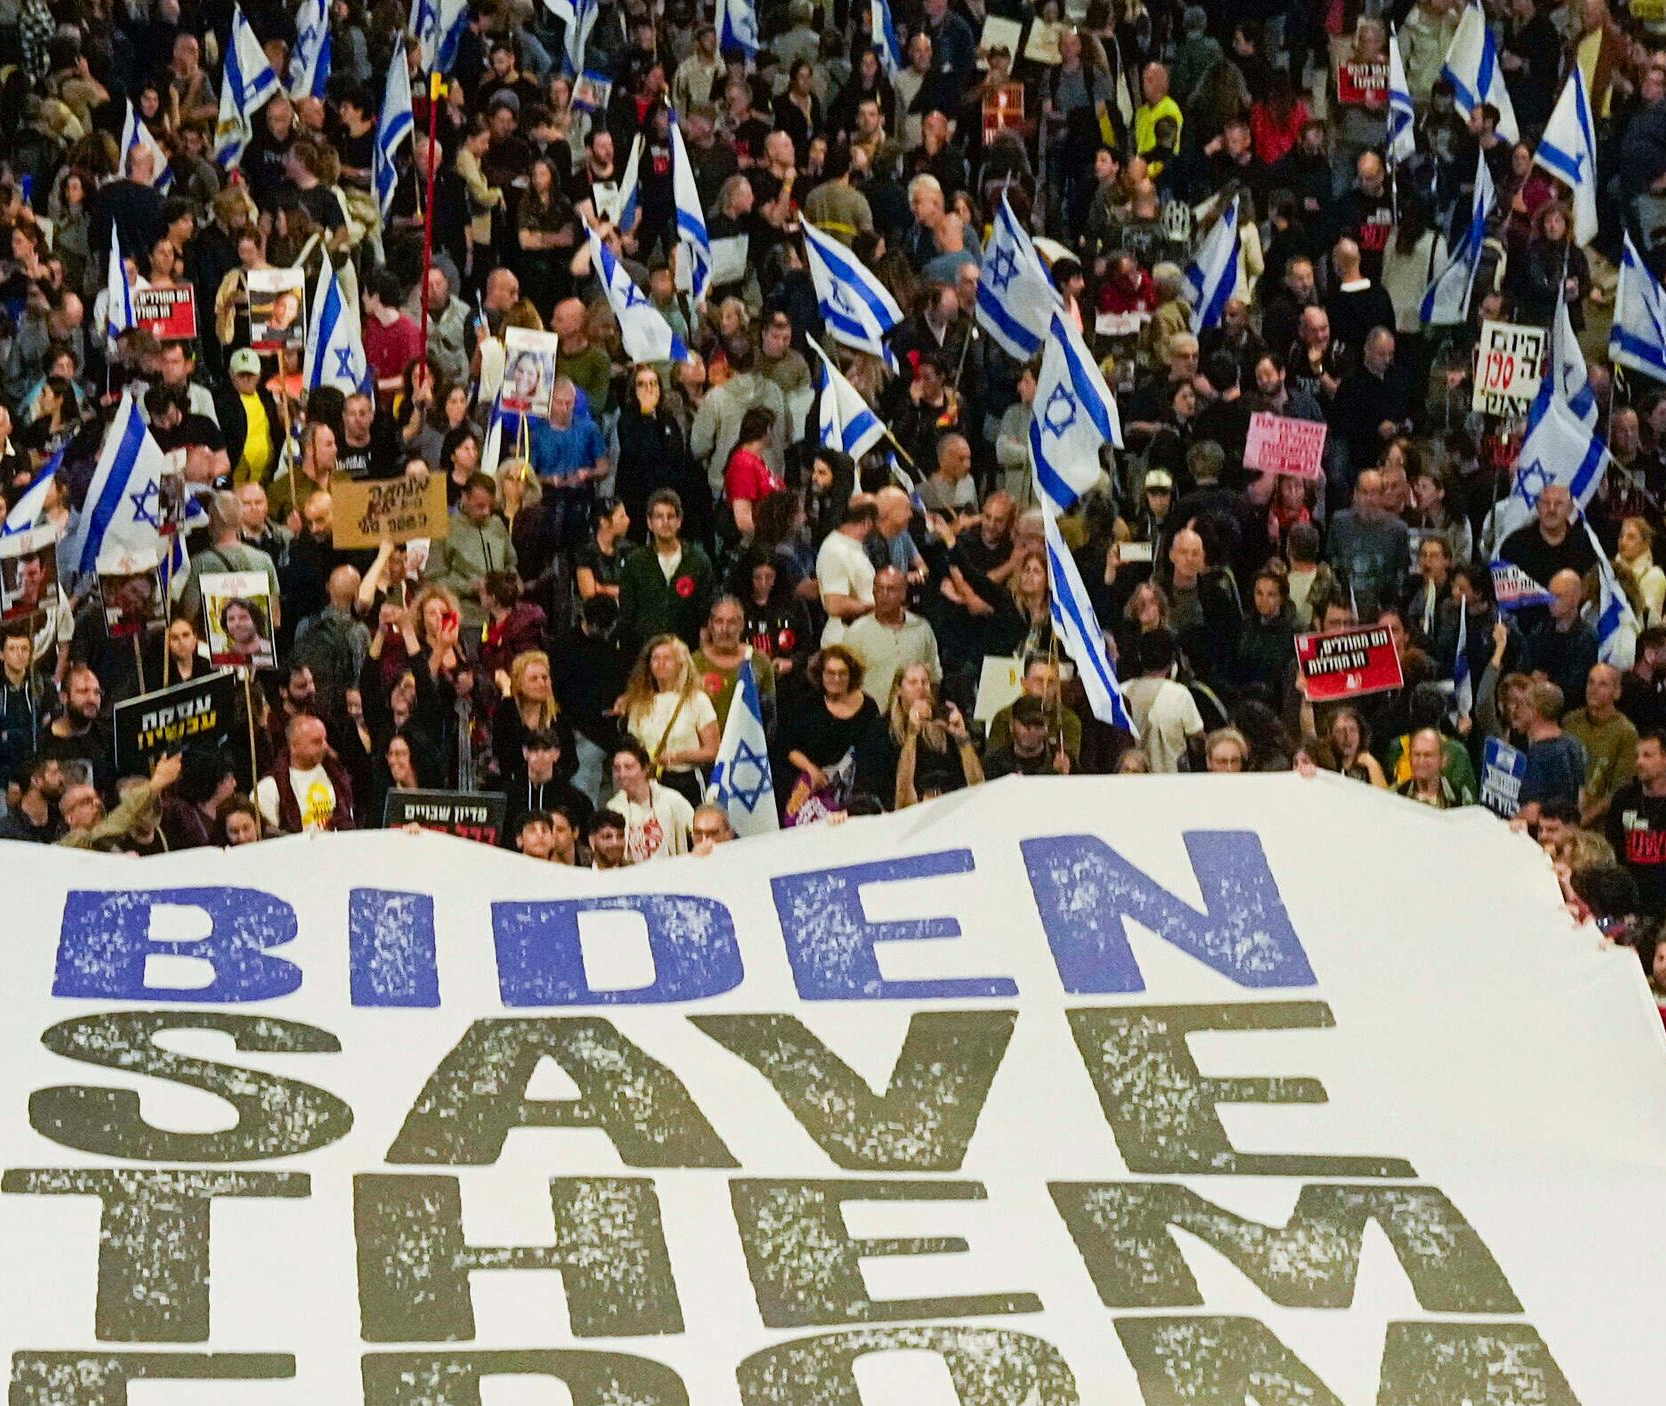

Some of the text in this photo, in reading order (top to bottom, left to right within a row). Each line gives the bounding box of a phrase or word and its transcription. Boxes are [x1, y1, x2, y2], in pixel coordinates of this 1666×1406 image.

[1490, 330, 1541, 354] היום
[141, 694, 211, 732] עסקה
[404, 804, 488, 824] פדיון שבויים
[52, 832, 1318, 1008] BIDEN
[27, 1002, 1417, 1178] SAVE
[1, 1171, 1524, 1343] THEM
